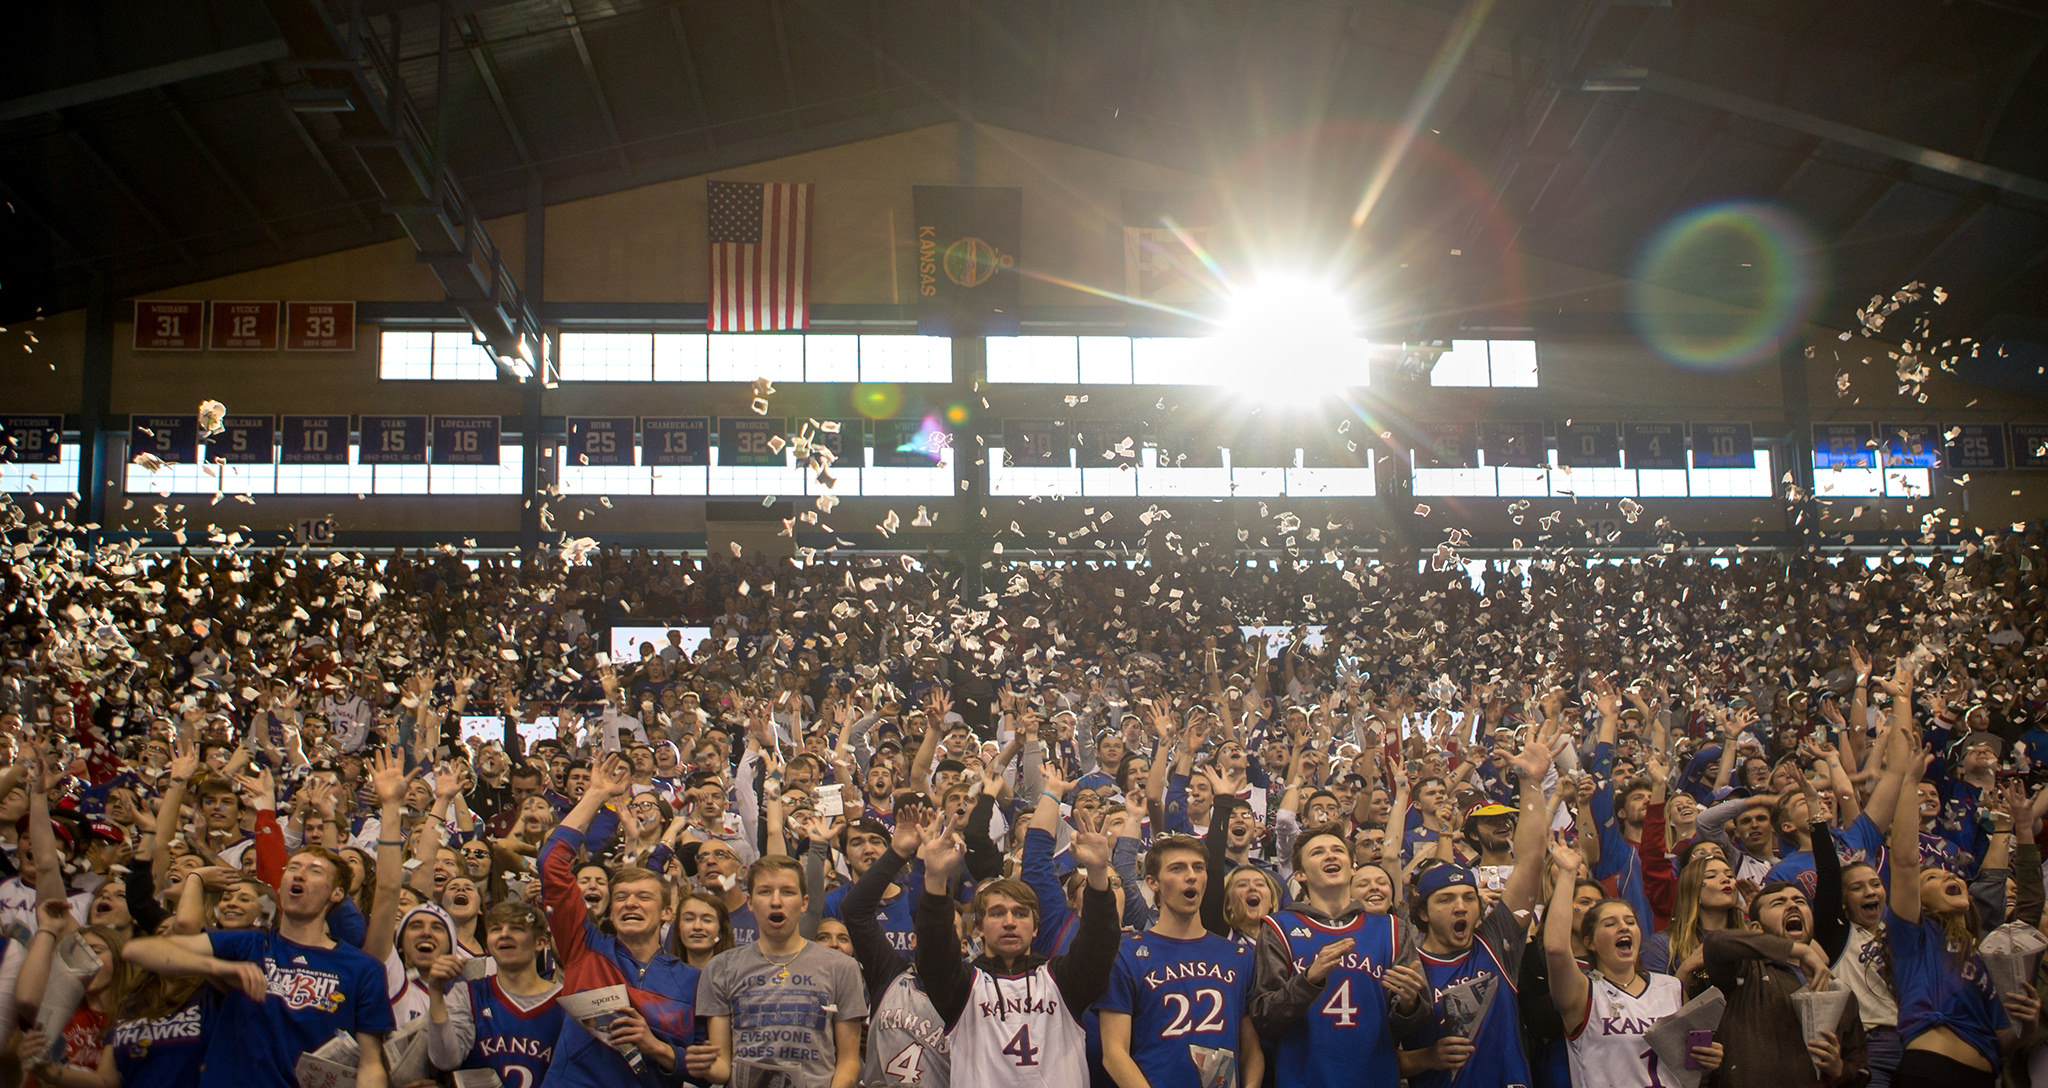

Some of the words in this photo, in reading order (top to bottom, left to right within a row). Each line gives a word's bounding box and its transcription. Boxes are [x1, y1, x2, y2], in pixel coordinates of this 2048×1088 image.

[920, 226, 936, 297] KANSAS
[156, 315, 181, 338] 31
[232, 315, 257, 338] 12
[306, 315, 335, 338] 33
[303, 419, 328, 428] BLACK
[440, 419, 493, 428] LOVELLETTE
[646, 421, 704, 430] CHAMBERLAIN
[12, 428, 43, 451] 36
[156, 429, 171, 451] 5
[232, 429, 247, 452] 5
[302, 430, 328, 452] 10
[381, 430, 405, 452] 15
[453, 430, 478, 453] 16
[585, 431, 616, 453] 25
[663, 431, 688, 453] 13
[737, 432, 767, 454] 32
[1581, 435, 1595, 456] 0
[1649, 436, 1662, 457] 4
[1712, 436, 1736, 457] 10
[1963, 436, 1989, 458] 25
[301, 520, 330, 541] 10
[331, 720, 348, 735] 15
[296, 968, 340, 980] BASKETBALL
[1144, 961, 1237, 990] KANSAS
[1292, 953, 1384, 979] KSAS
[791, 974, 816, 987] OK.
[591, 993, 620, 1006] sports
[978, 996, 1058, 1018] KANSAS
[1322, 979, 1358, 1026] 4
[657, 1007, 695, 1039] KU
[1161, 988, 1224, 1037] 22
[740, 1030, 812, 1044] EVERYONE
[1601, 1016, 1658, 1036] KAN
[480, 1035, 553, 1063] KANSA
[778, 1046, 820, 1061] HERE
[1002, 1023, 1039, 1067] 4
[885, 1041, 925, 1084] 4
